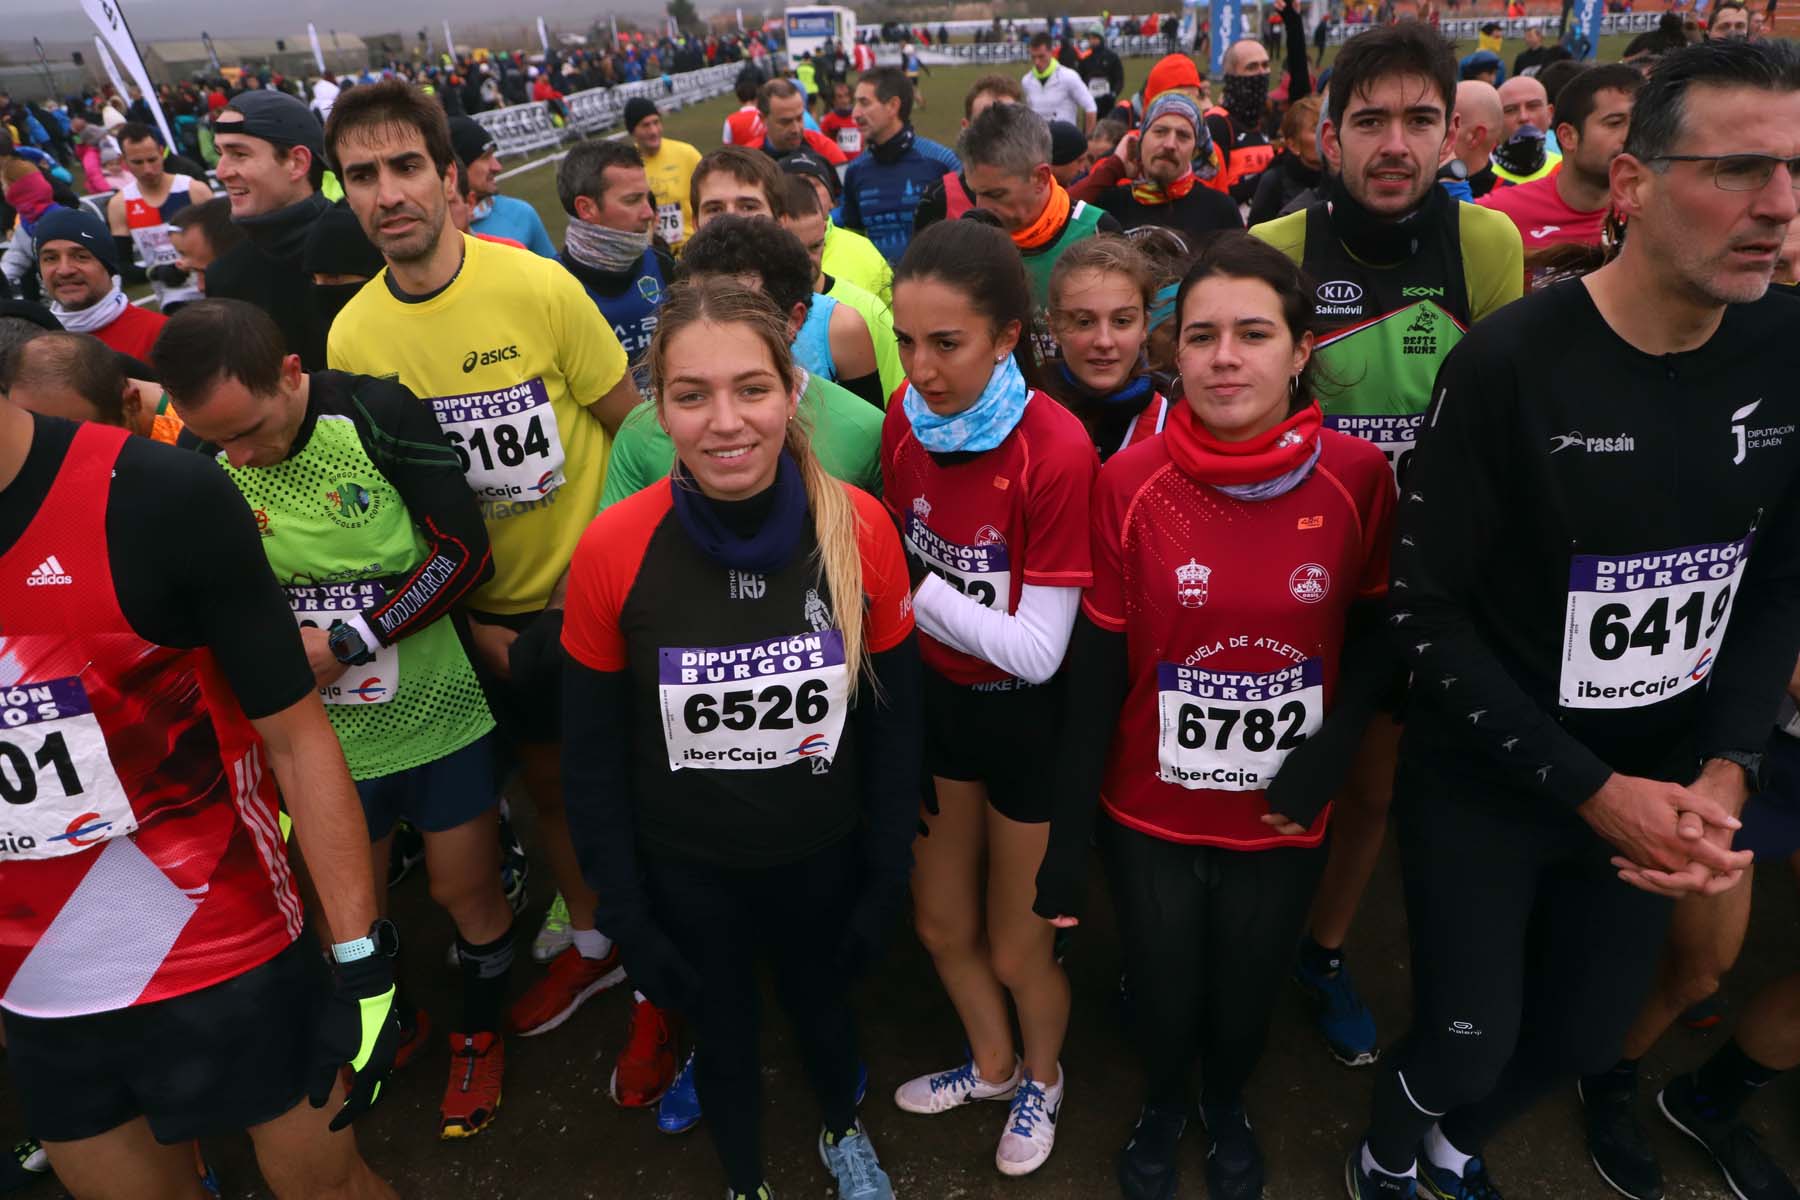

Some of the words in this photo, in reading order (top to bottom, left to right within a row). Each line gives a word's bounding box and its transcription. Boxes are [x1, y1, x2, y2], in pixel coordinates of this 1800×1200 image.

[1324, 286, 1355, 298] KIA
[1315, 304, 1362, 315] Sakimóvil
[480, 345, 518, 366] asics
[432, 384, 532, 411] DIPUTACIÓN
[435, 395, 536, 423] BURGOS
[1586, 432, 1634, 453] rasán
[1747, 424, 1795, 439] DIPUTACIÓN
[1748, 440, 1760, 449] DE
[1761, 437, 1782, 448] JAÉN
[473, 484, 522, 498] rCaja
[912, 518, 988, 560] DPUTACIÓN
[912, 529, 990, 572] BURGOS
[27, 574, 72, 586] adidas
[378, 554, 457, 634] MODUMARCHA
[1589, 583, 1731, 661] 6419
[681, 635, 822, 667] DIPUTACIÓN
[1181, 641, 1225, 667] CUELA
[1229, 635, 1248, 648] DE
[681, 651, 825, 683] BURGOS
[1177, 666, 1303, 687] DIPUTACIÓN
[1178, 678, 1303, 700] BURGOS
[1577, 676, 1680, 699] iberCaja
[3, 702, 60, 726] OS
[683, 678, 830, 735] 6526
[1177, 700, 1307, 753] 6782
[683, 747, 778, 764] iberCaja
[1171, 766, 1258, 786] iberCaja
